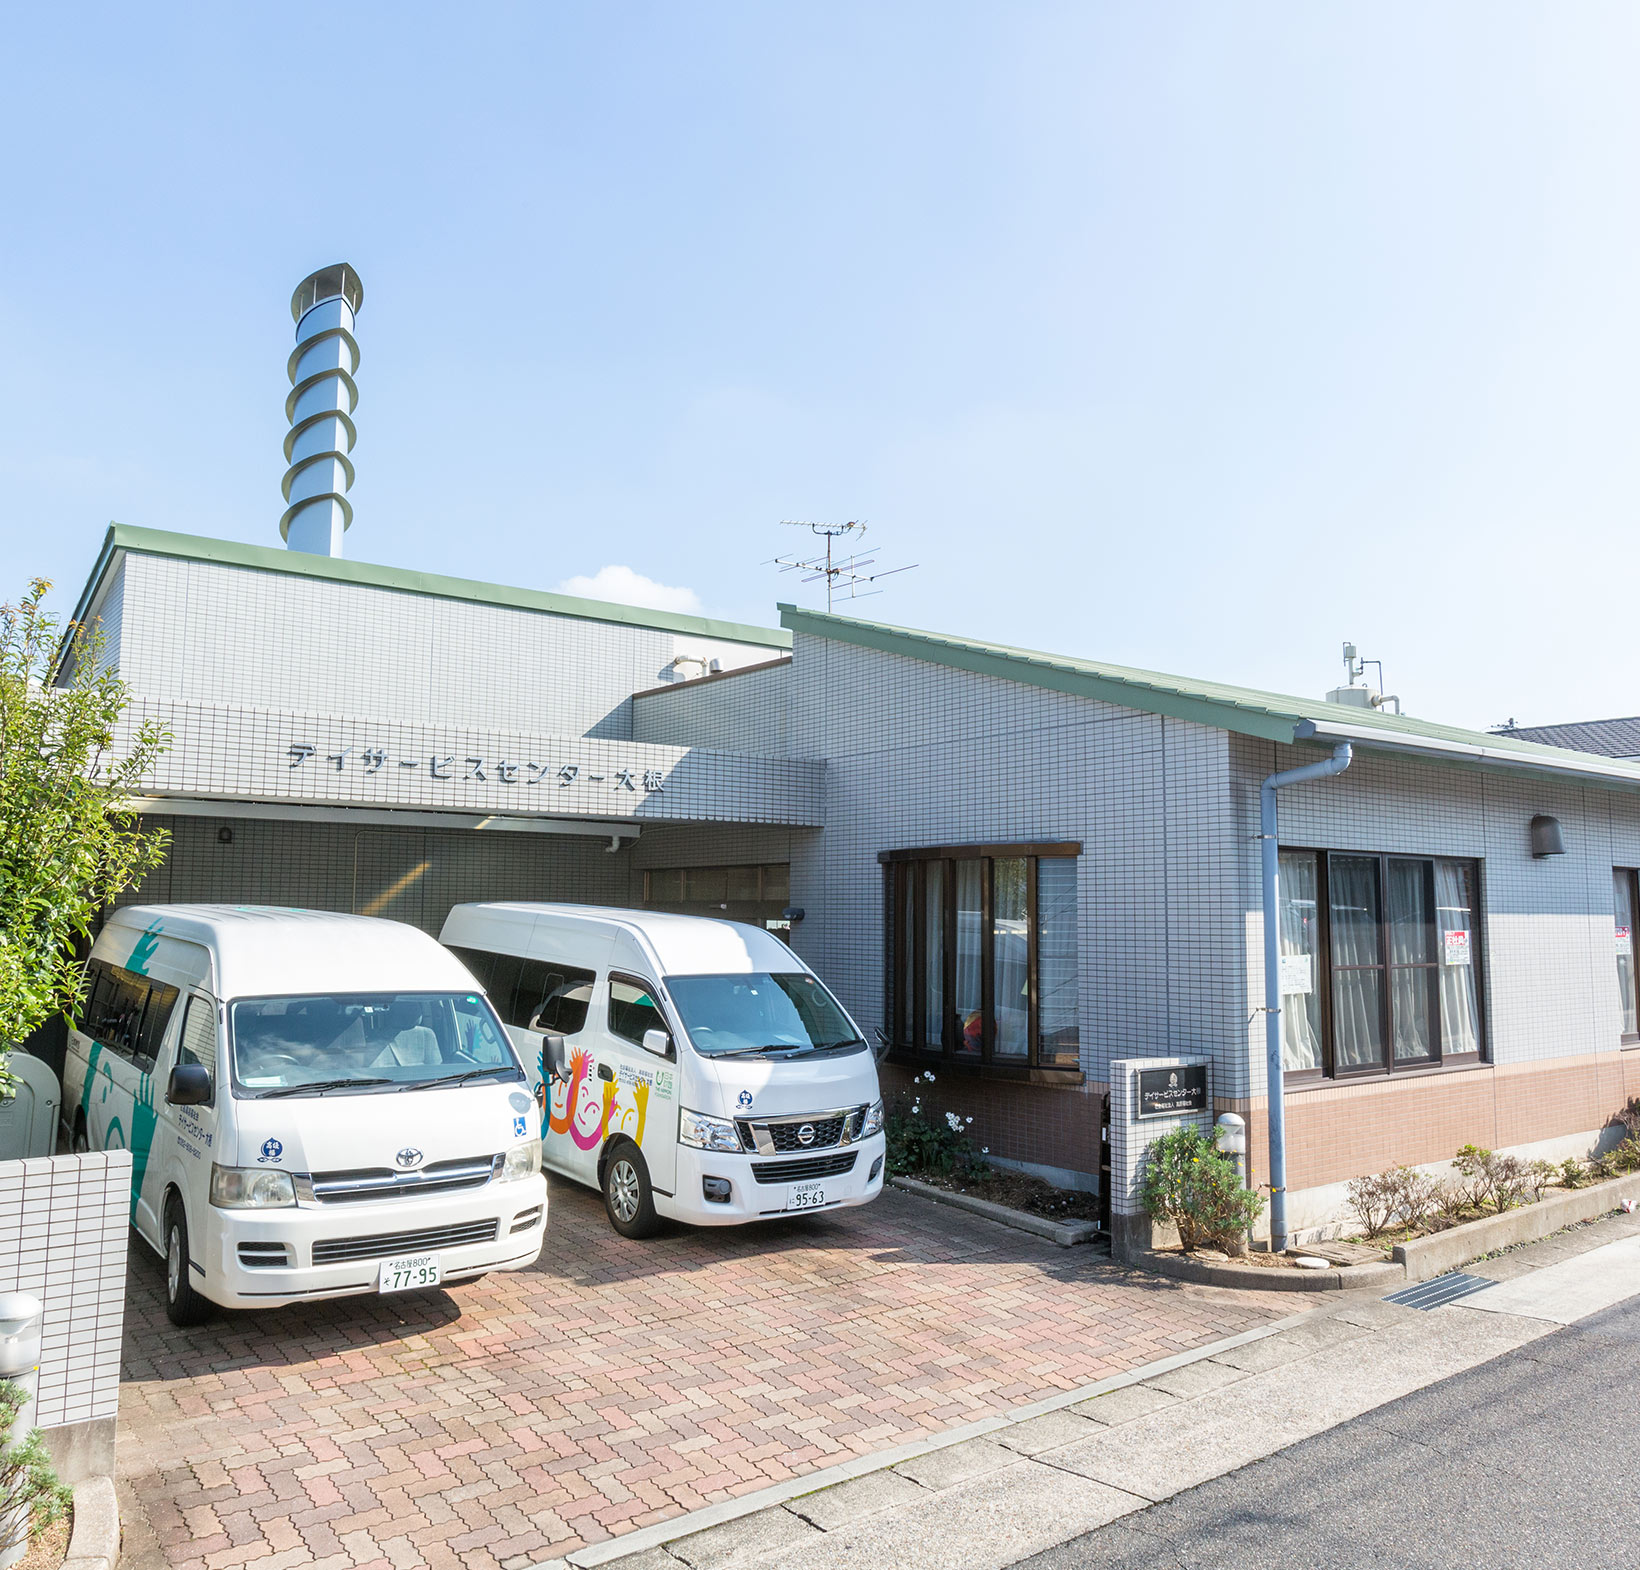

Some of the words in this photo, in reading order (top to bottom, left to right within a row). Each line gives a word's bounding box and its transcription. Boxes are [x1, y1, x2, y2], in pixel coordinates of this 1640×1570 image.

[288, 742, 665, 792] デイサービスセンター大根
[796, 1191, 824, 1207] 95-63
[393, 1266, 437, 1289] 77-95
